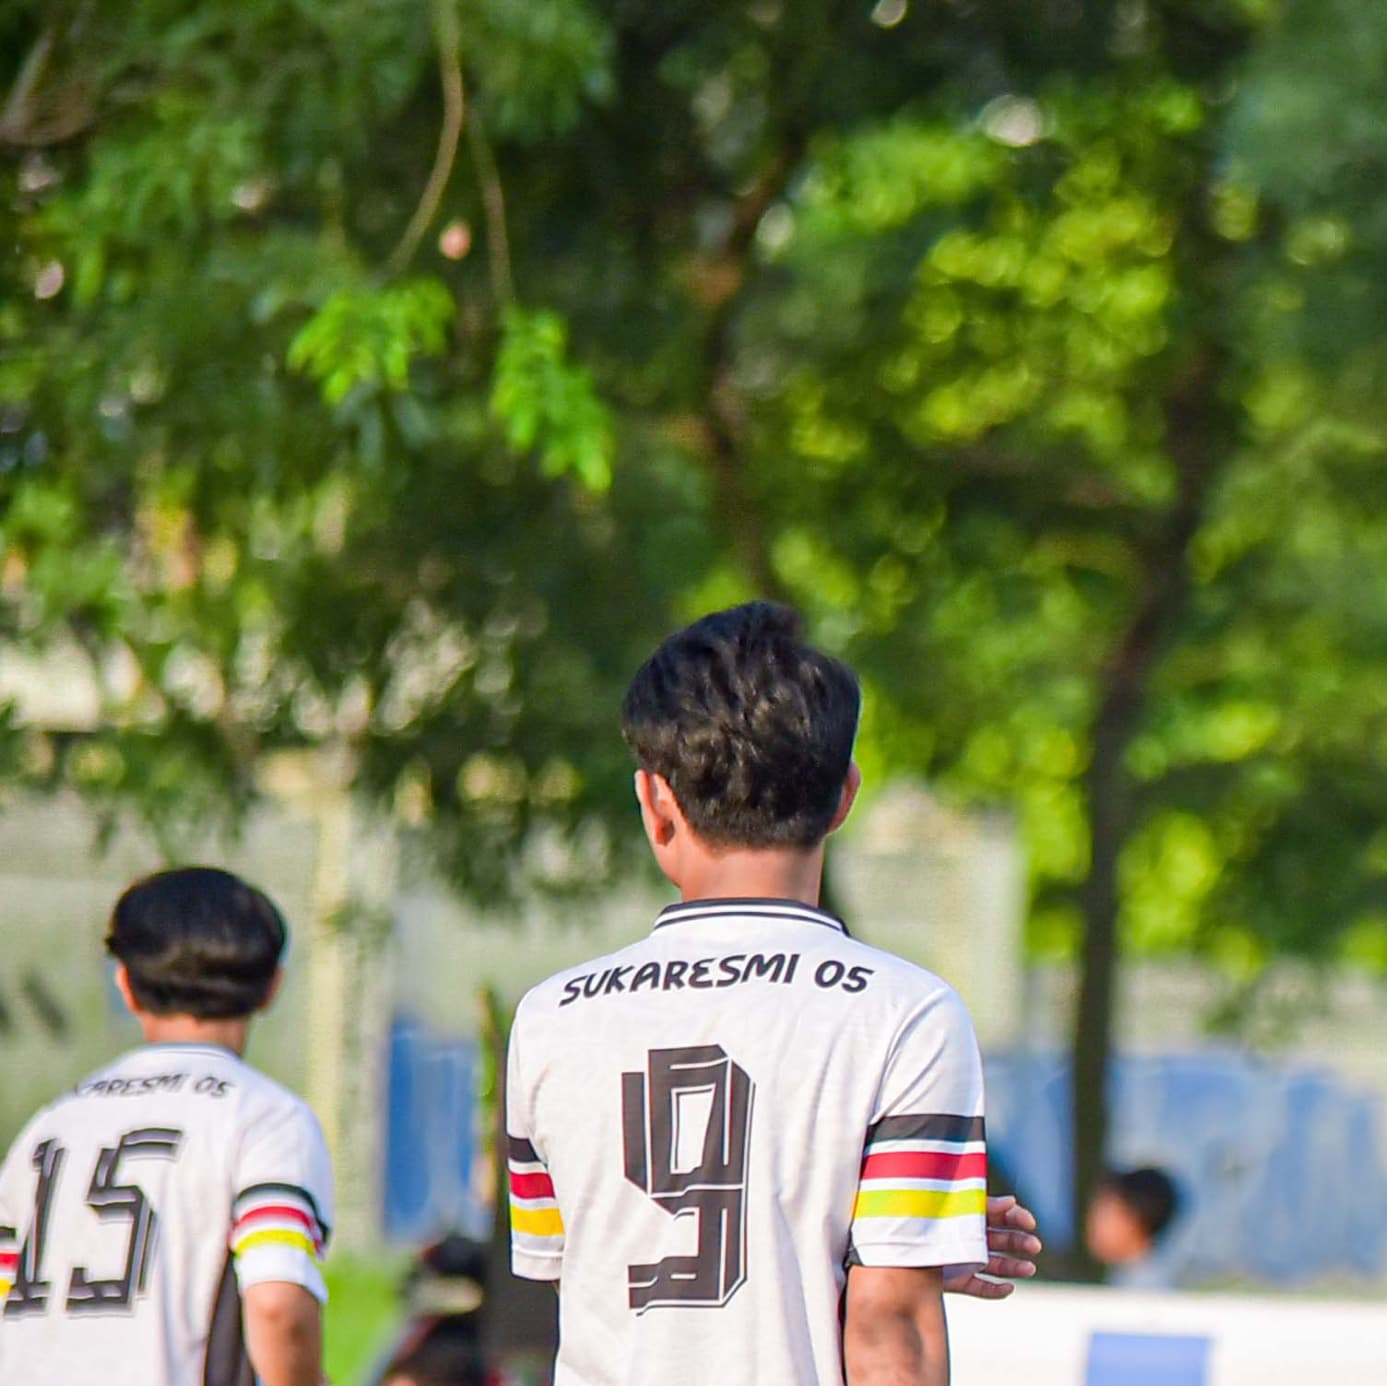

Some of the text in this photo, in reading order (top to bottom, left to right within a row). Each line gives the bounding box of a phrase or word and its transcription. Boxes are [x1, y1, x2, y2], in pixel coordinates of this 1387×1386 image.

[558, 953, 875, 1007] SUKARESMI 05
[193, 1075, 236, 1098] 05
[3, 1127, 183, 1320] 15
[621, 1044, 757, 1317] 9
